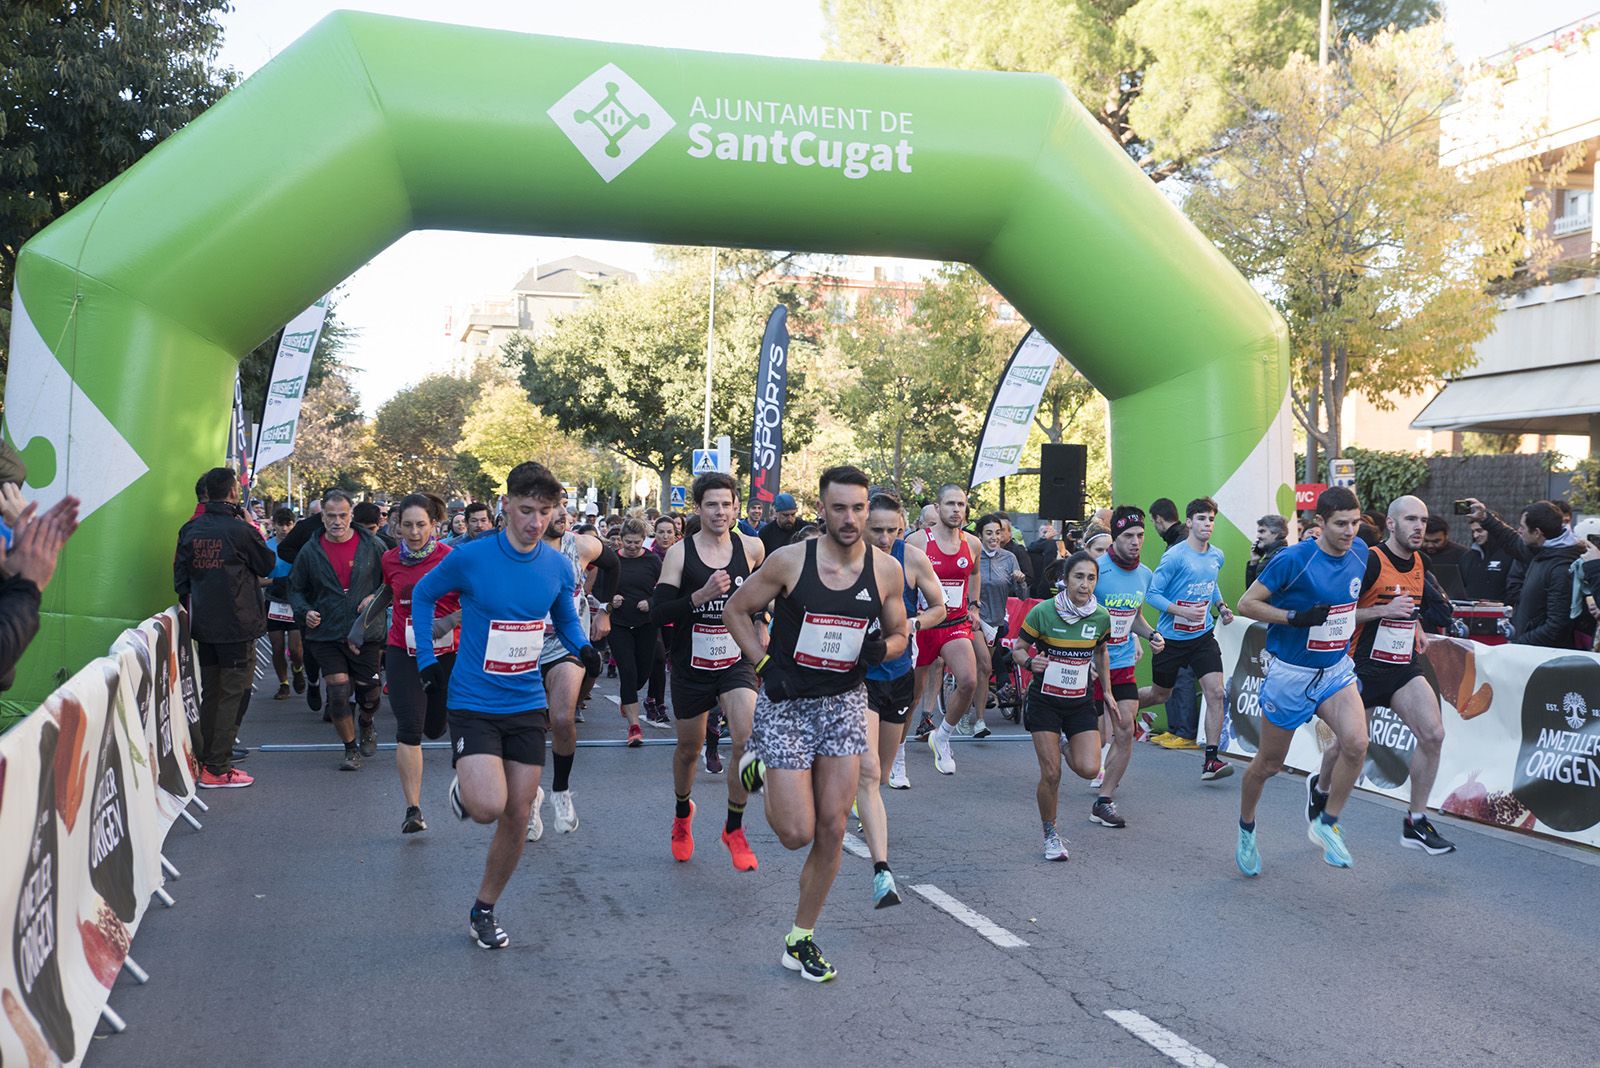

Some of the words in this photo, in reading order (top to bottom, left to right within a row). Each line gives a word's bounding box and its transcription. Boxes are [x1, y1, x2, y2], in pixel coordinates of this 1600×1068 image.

[689, 96, 873, 131] AJUNTAMENT
[880, 111, 914, 135] DE
[686, 122, 914, 180] SantCugat
[760, 343, 784, 471] SPORTS
[192, 539, 223, 550] MITJA
[194, 549, 221, 559] SANT
[192, 559, 224, 569] CUGAT
[823, 631, 843, 641] ADRIA
[508, 646, 528, 658] 3283
[821, 641, 841, 654] 3189
